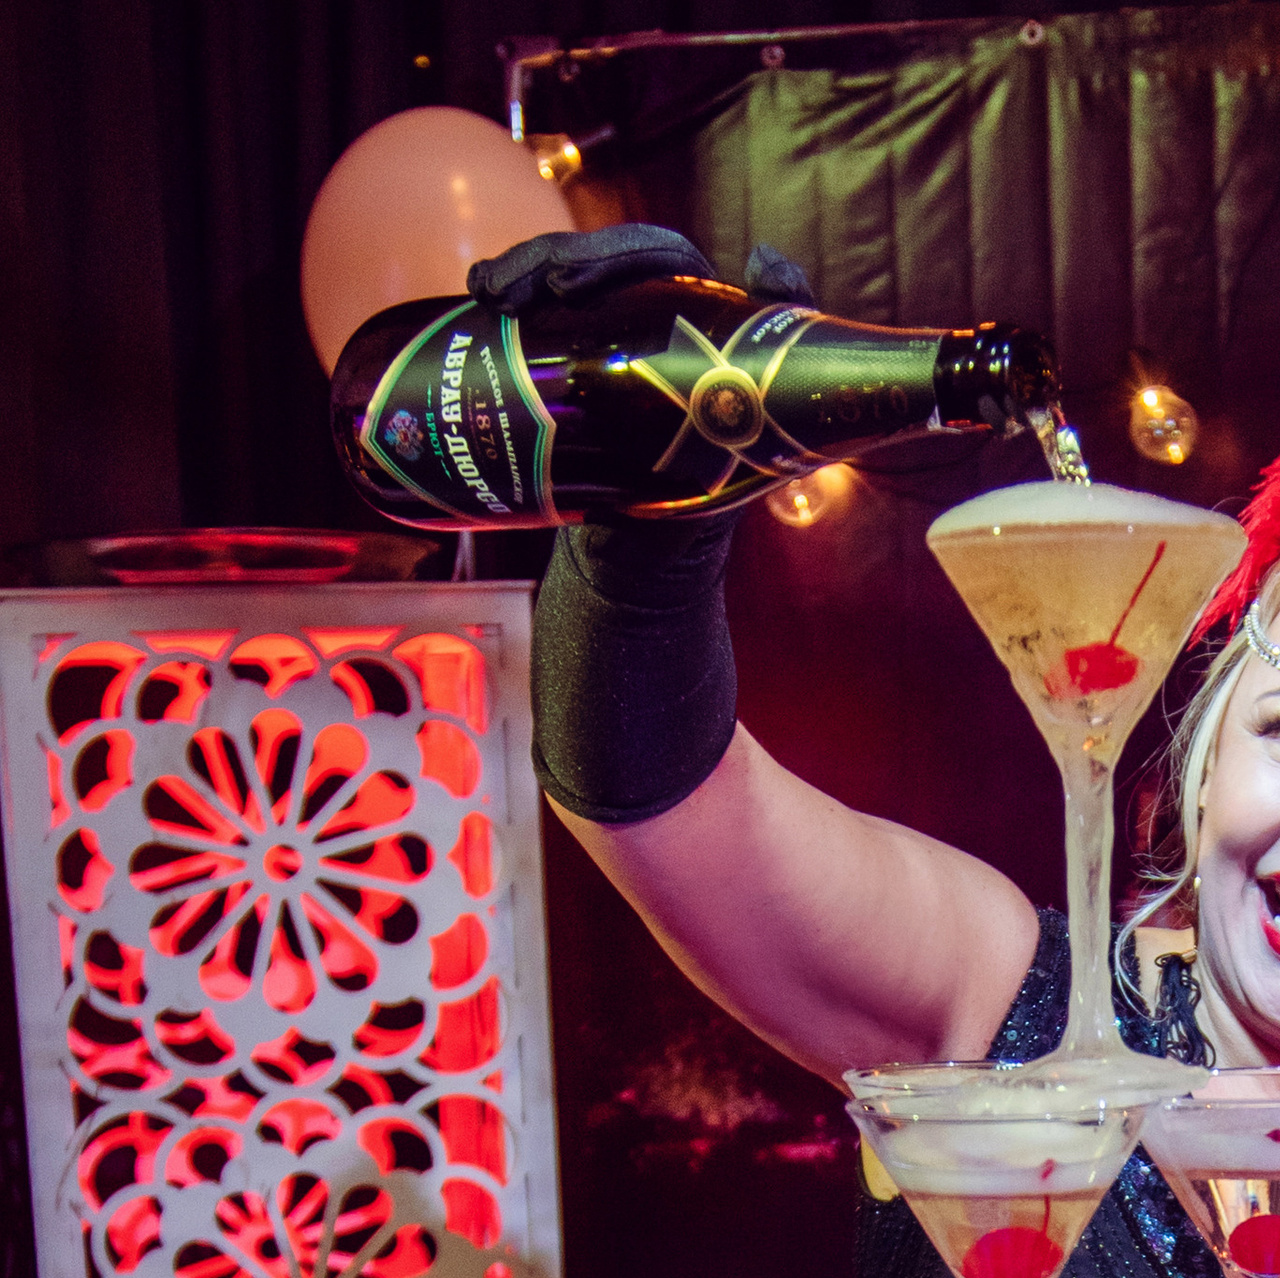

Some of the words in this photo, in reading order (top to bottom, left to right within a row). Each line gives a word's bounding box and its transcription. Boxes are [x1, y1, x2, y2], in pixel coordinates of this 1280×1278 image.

[480, 345, 504, 408] РУССКОЕ
[426, 412, 445, 458] БРЮТ
[441, 331, 513, 514] АБРАУ-ДЮРСО
[475, 400, 498, 460] 1870
